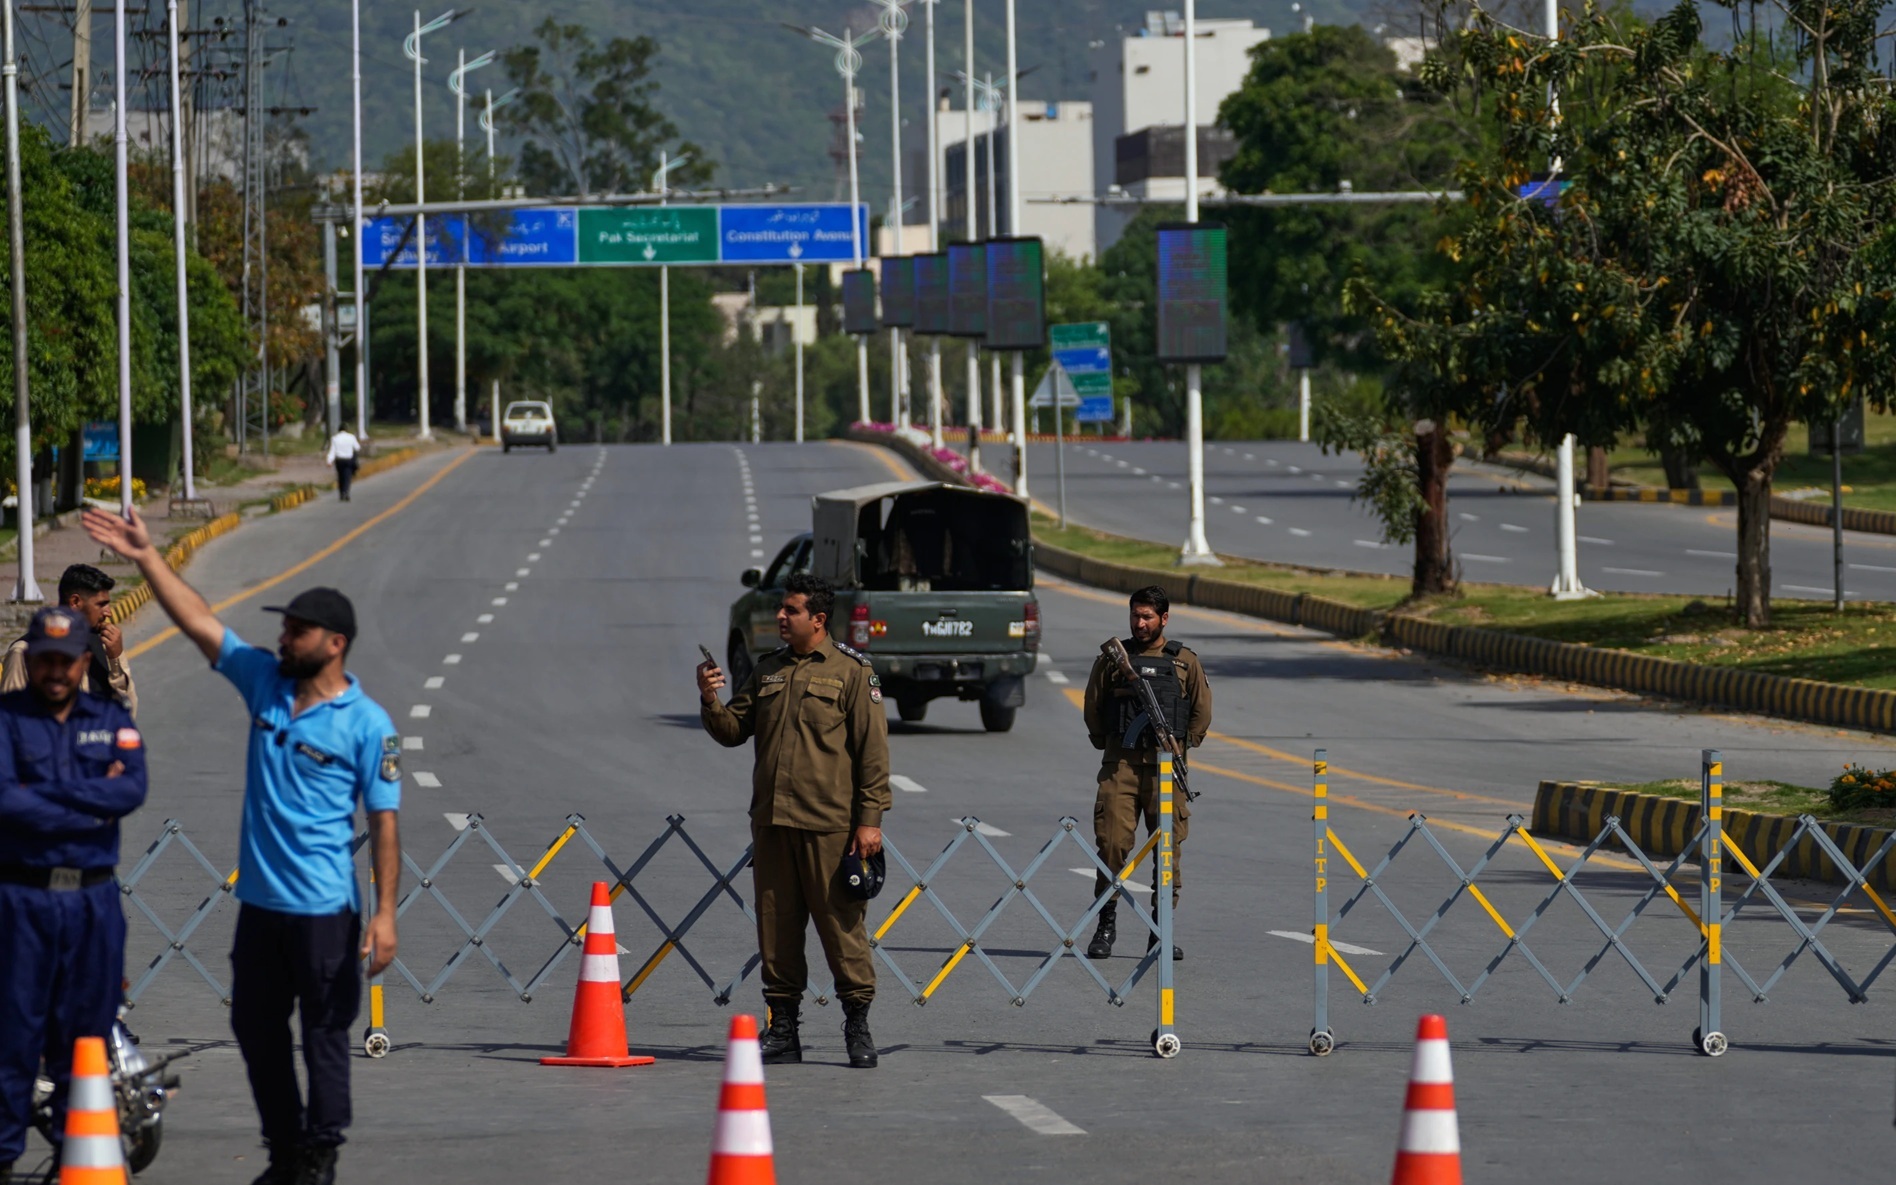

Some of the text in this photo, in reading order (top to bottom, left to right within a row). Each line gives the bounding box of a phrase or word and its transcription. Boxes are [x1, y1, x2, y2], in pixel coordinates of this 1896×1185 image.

[599, 231, 699, 242] Pak Secretariat
[726, 229, 854, 242] Constitution Avenu
[1160, 832, 1173, 886] ITP
[1315, 839, 1327, 893] ITP
[1709, 839, 1721, 893] ITP
